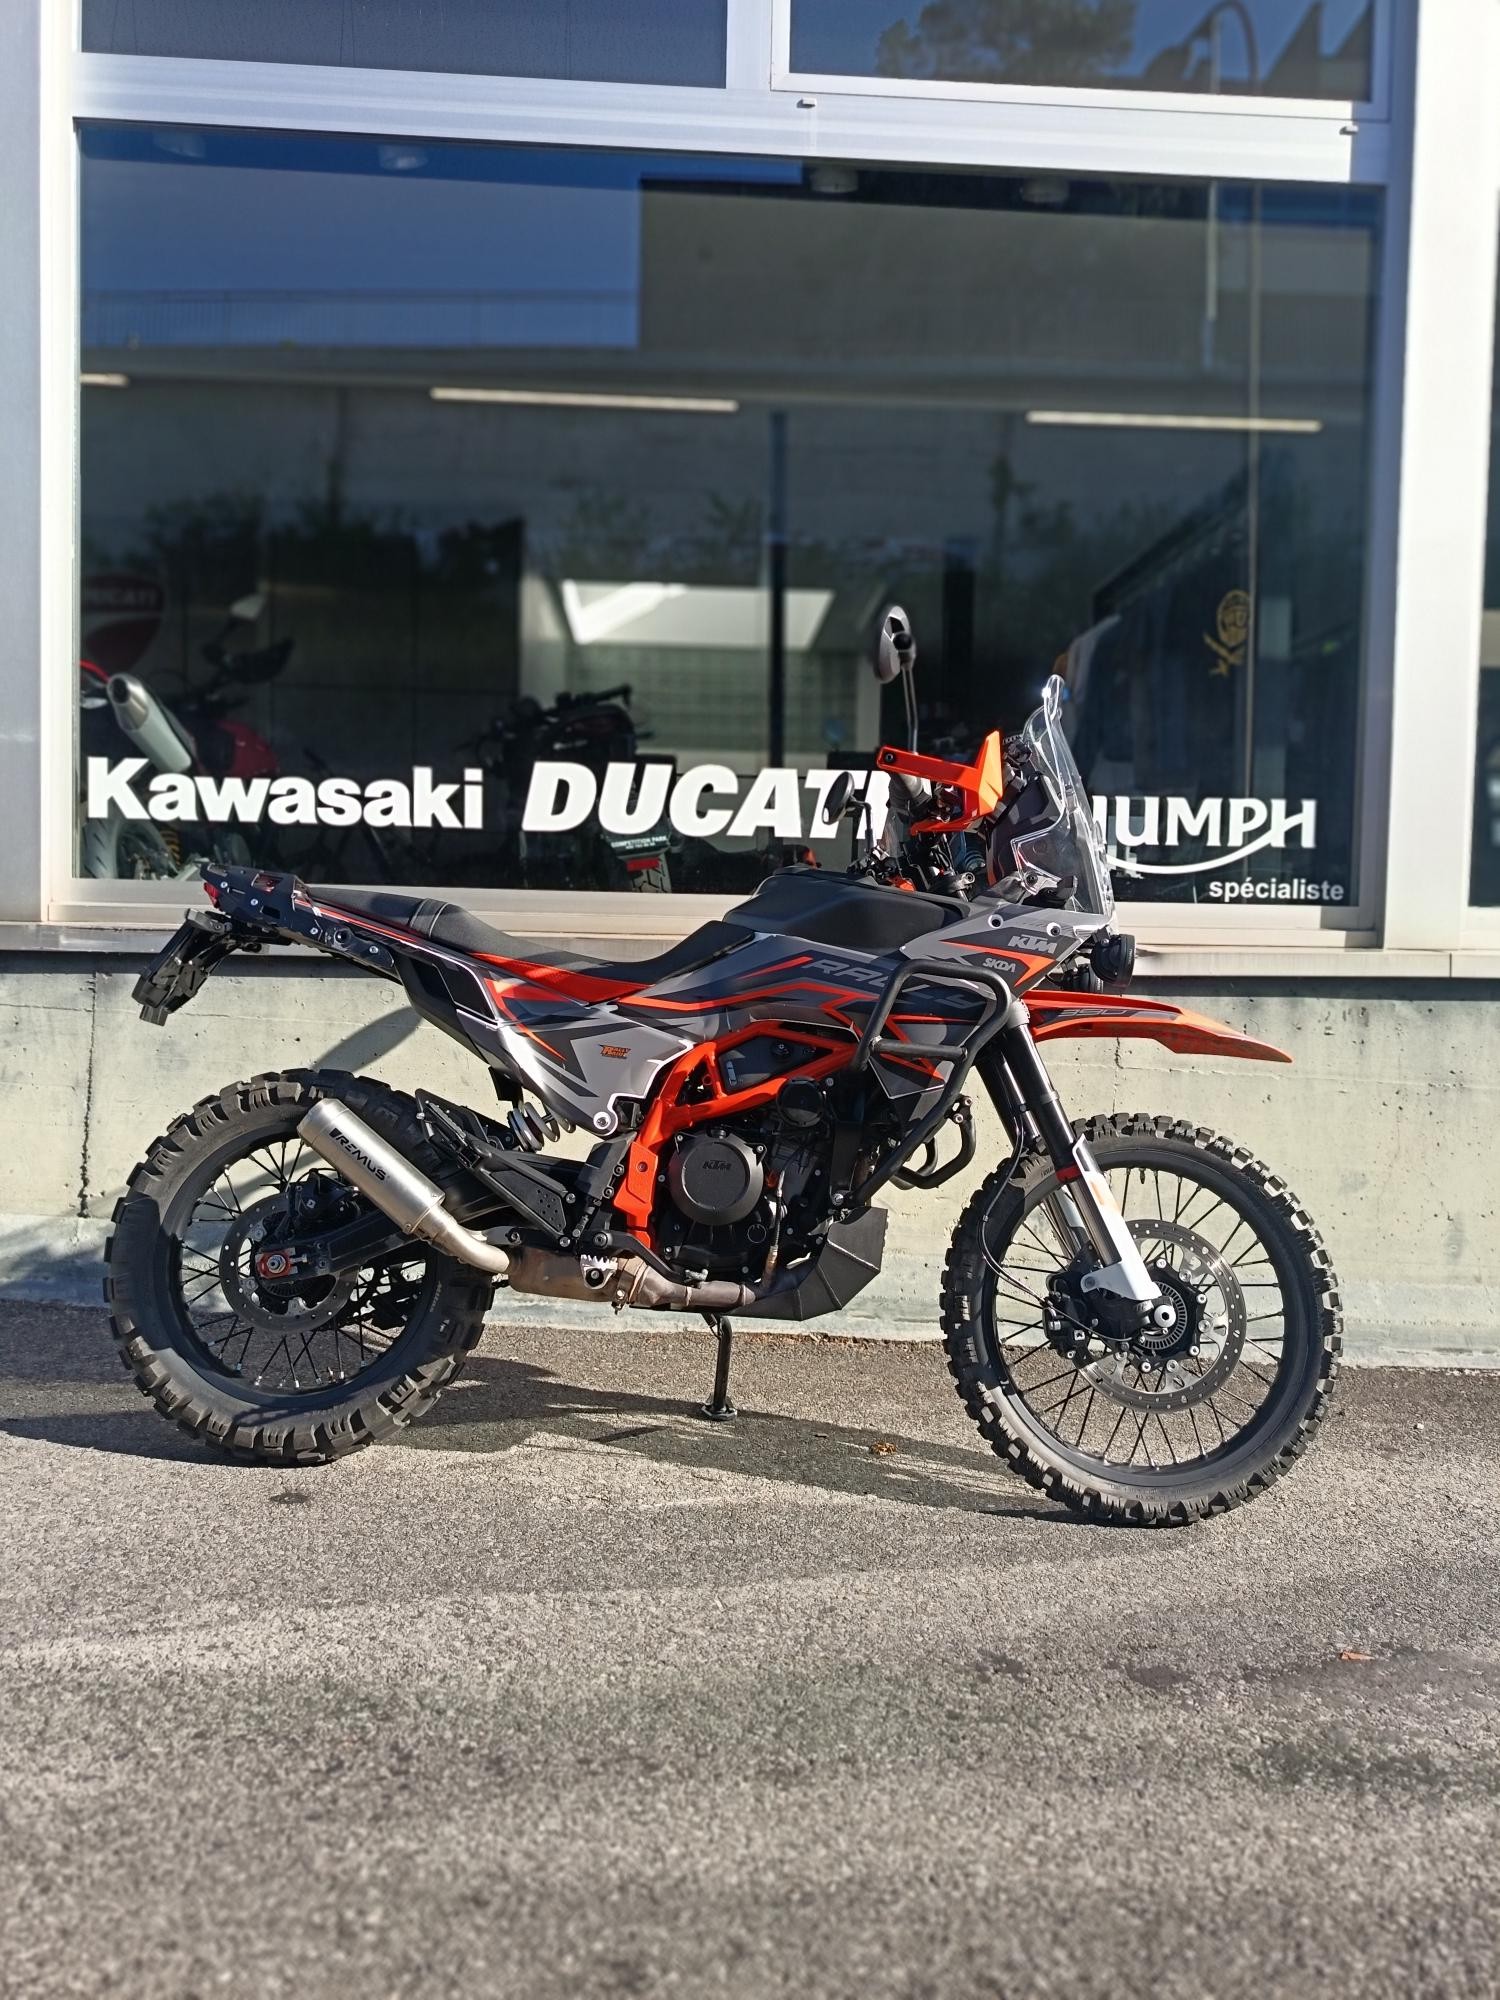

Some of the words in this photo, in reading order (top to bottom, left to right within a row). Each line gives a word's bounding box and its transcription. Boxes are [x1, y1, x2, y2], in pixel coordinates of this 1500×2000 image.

[88, 757, 483, 829] Kawasaki
[1209, 877, 1344, 902] spécialiste
[1008, 934, 1057, 954] KTM
[335, 1135, 386, 1181] REMUS
[702, 1159, 732, 1170] KTM
